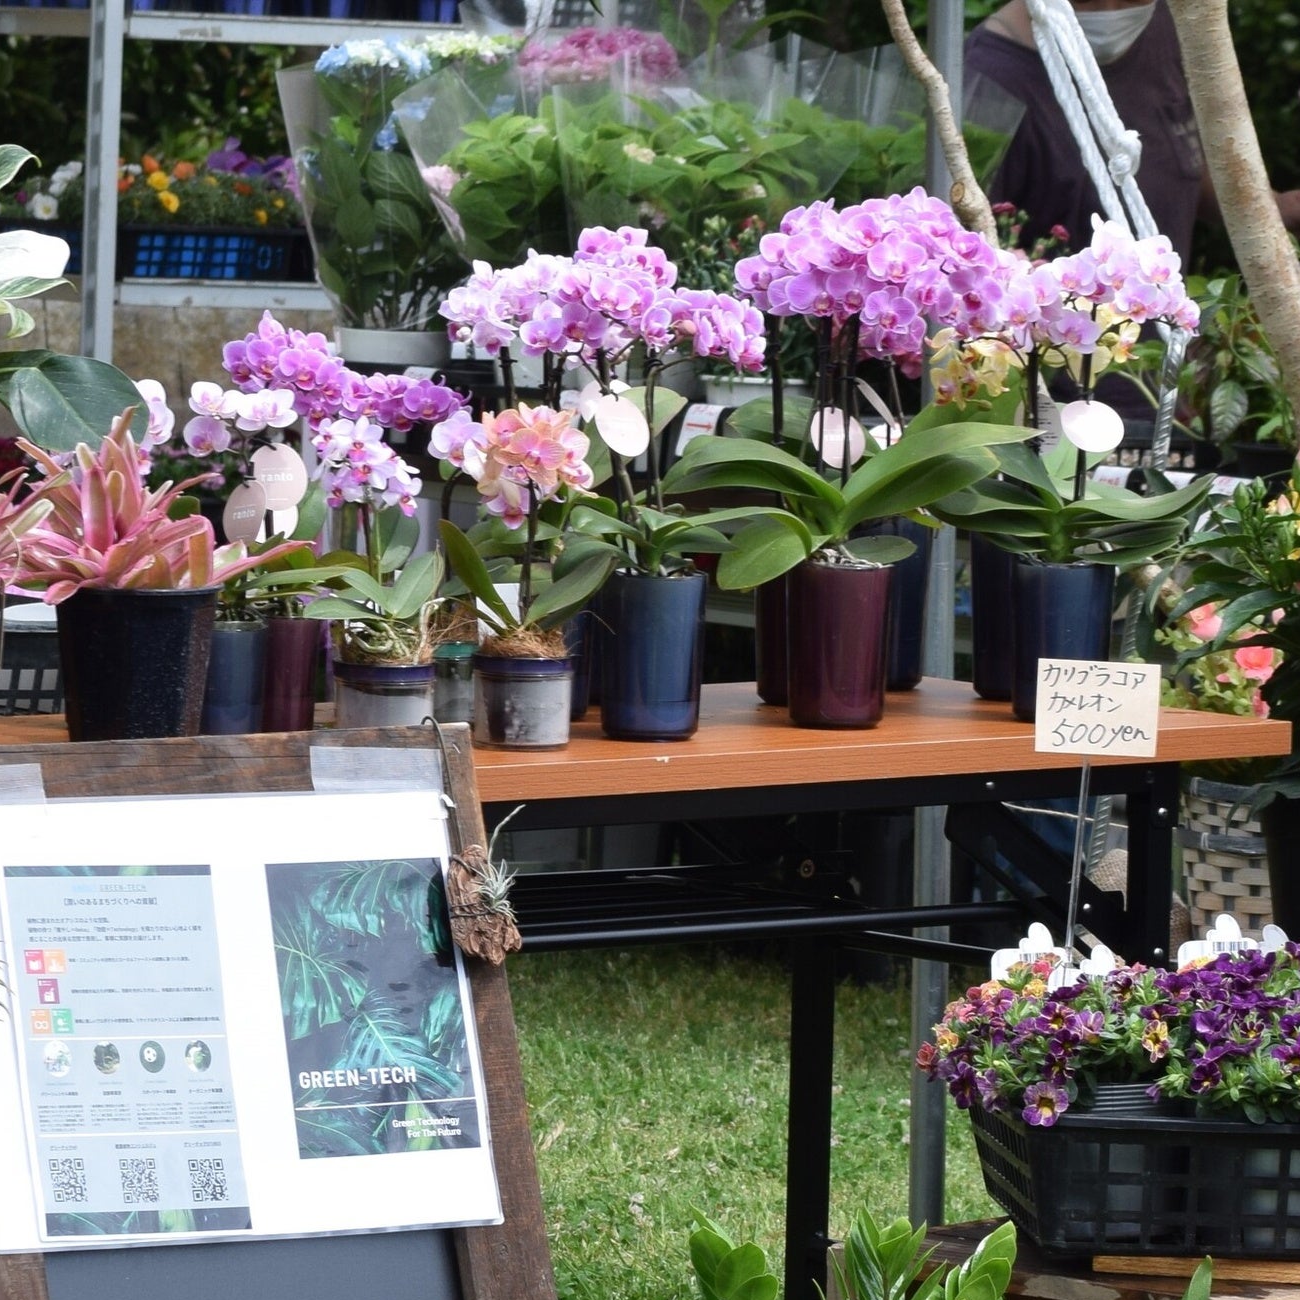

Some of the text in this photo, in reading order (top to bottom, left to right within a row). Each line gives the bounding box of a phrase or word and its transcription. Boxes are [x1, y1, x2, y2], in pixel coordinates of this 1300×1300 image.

[1043, 664, 1147, 690] カリブラコア
[1047, 692, 1123, 713] カメレオン
[1052, 718, 1151, 748] 500yen
[299, 1066, 417, 1088] GREEN-TECH
[392, 1116, 460, 1128] Green Technology
[407, 1127, 461, 1138] For The Future
